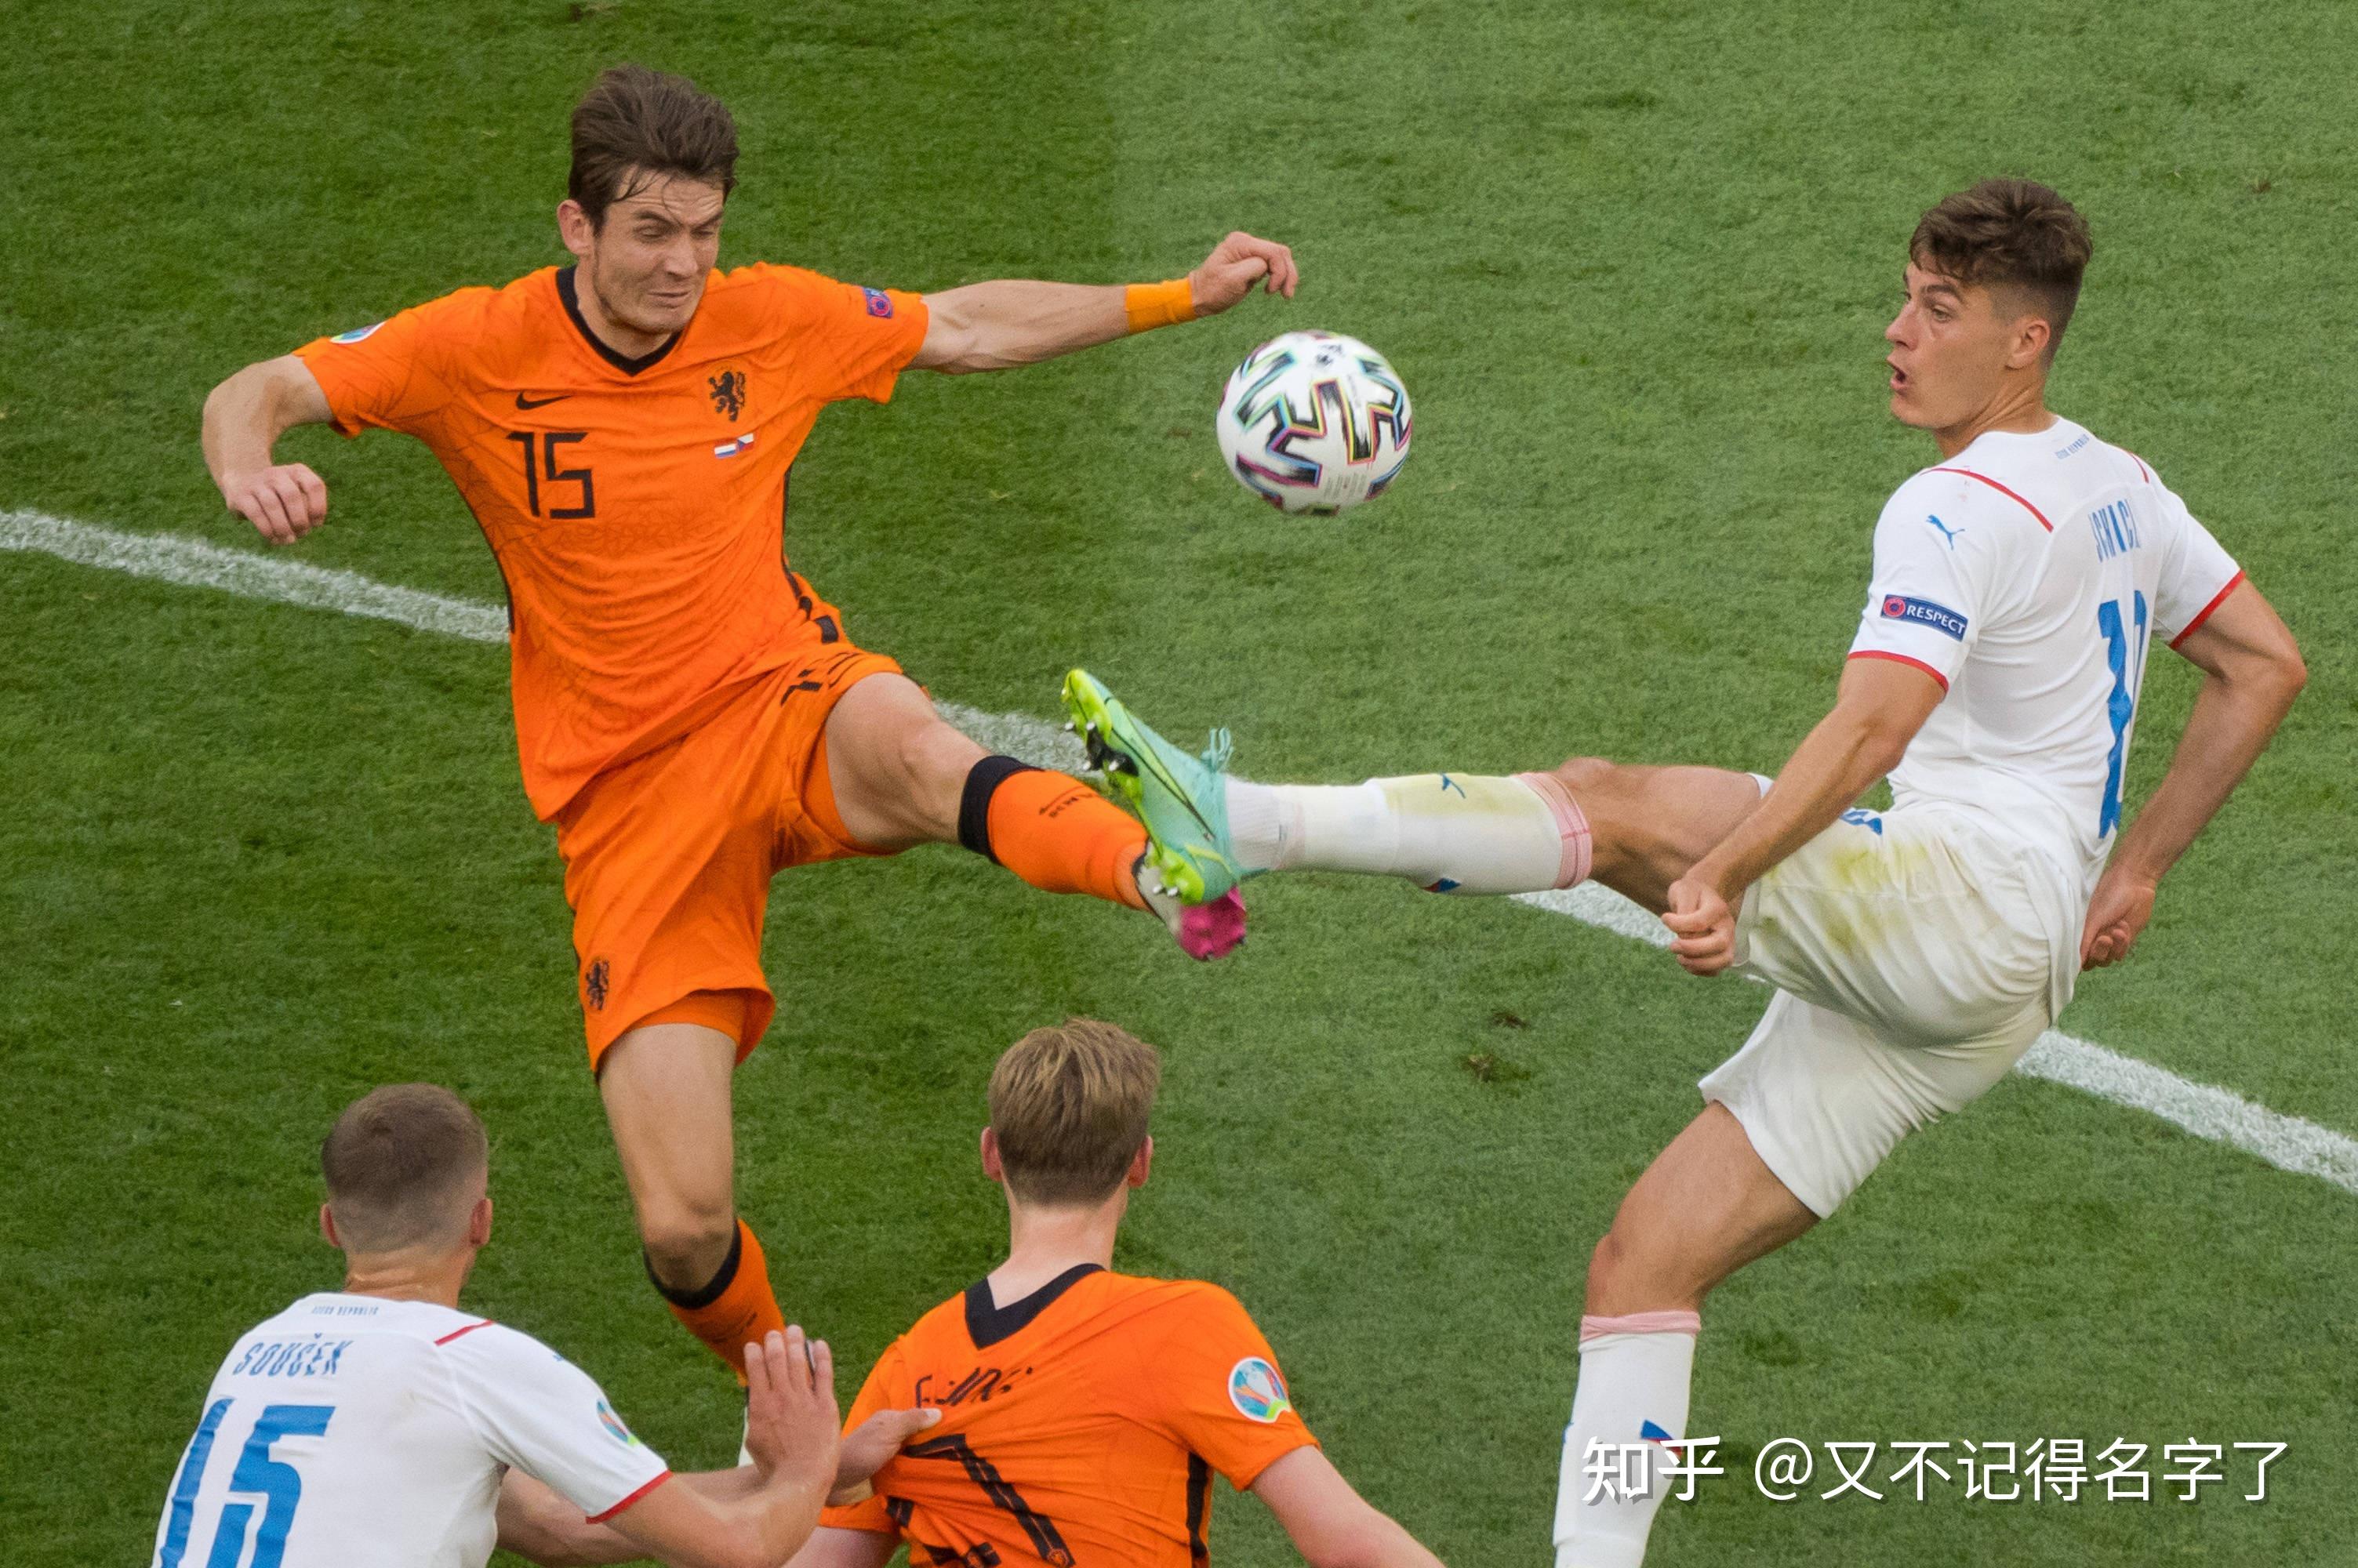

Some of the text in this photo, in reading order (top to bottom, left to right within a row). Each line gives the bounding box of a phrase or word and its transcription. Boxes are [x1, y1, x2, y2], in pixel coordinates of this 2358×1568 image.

[506, 431, 595, 520] 15
[1907, 604, 1965, 633] RESPECT
[160, 1398, 336, 1568] 15
